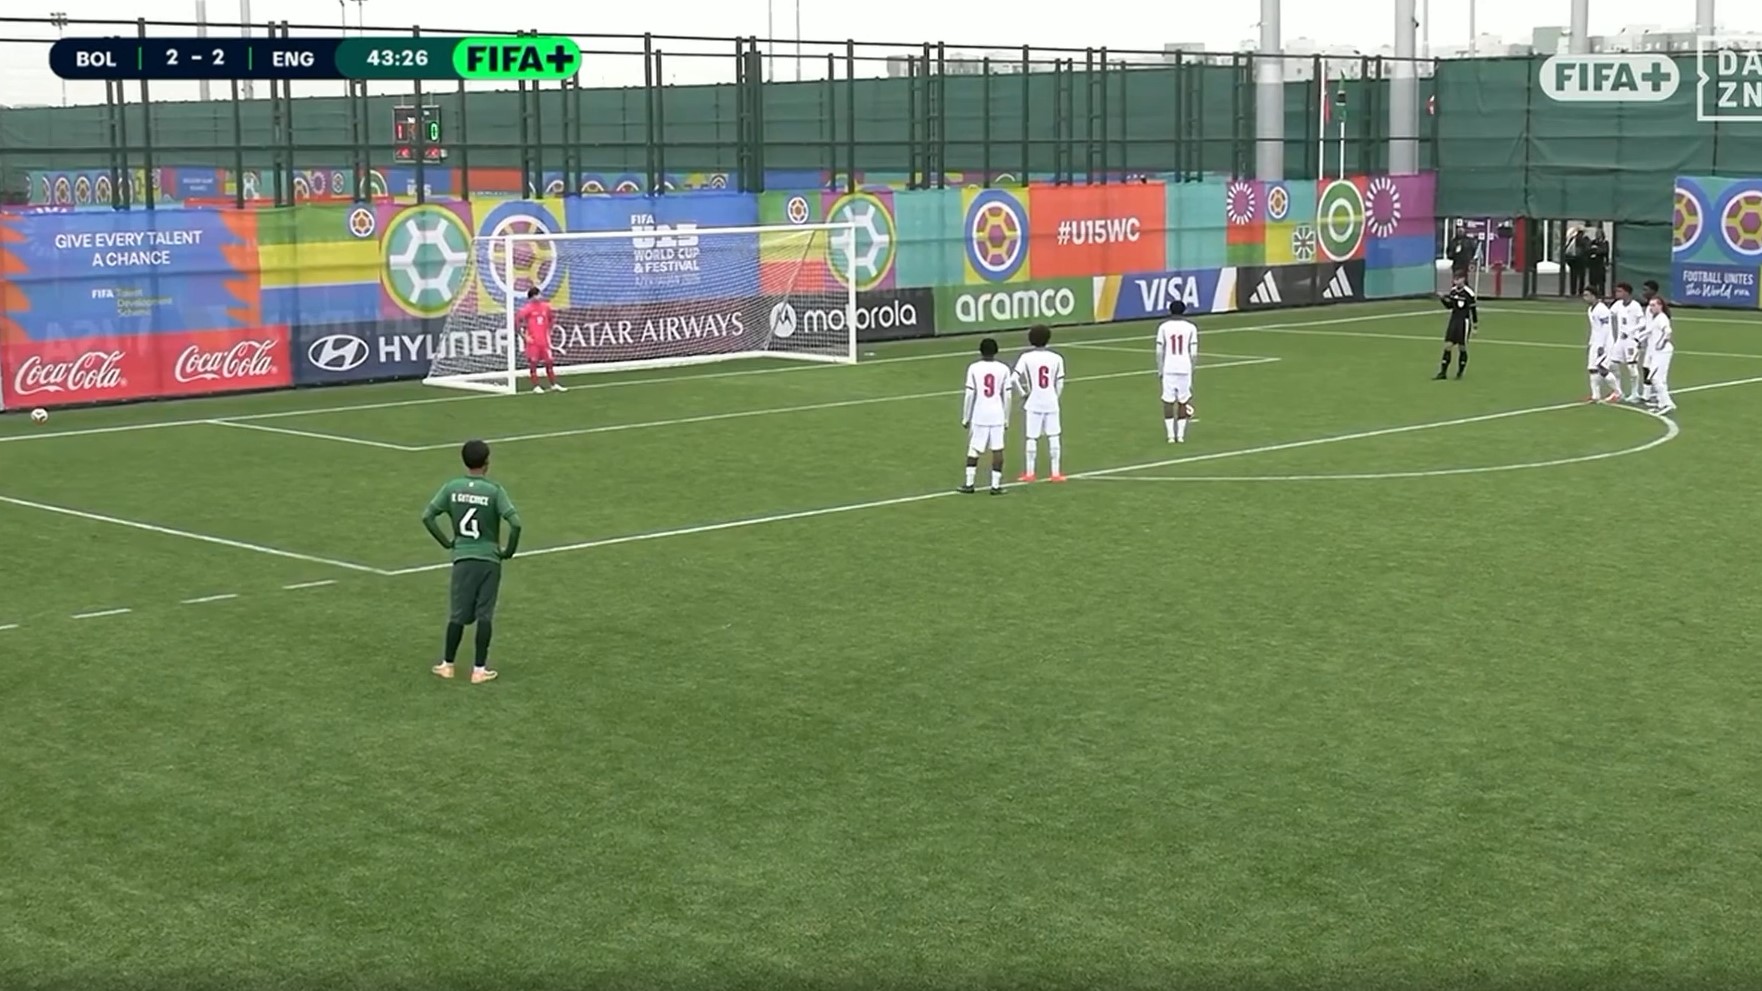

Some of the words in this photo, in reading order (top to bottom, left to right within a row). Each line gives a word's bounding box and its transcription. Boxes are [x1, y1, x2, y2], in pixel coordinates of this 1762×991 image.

[430, 122, 439, 141] 0
[630, 214, 655, 225] FIFA
[55, 233, 92, 249] GIVE
[95, 231, 144, 248] EVERY
[147, 230, 203, 246] TALENT
[1057, 217, 1141, 246] #U15WC
[92, 253, 104, 267] A
[106, 251, 170, 266] CHANCE
[633, 249, 675, 262] WORLD
[677, 247, 701, 260] CUP
[633, 262, 643, 274] &
[645, 260, 700, 273] FESTIVAL
[1683, 270, 1722, 284] FOOTBALL
[1723, 272, 1754, 285] UNITES
[92, 289, 114, 299] FIFA
[1135, 276, 1200, 313] VISA
[1702, 283, 1733, 300] World
[956, 288, 1075, 323] aramco
[547, 319, 634, 355] QATAR
[641, 311, 745, 343] AIRWAYS
[1170, 334, 1184, 355] 11
[983, 373, 995, 398] 9
[1038, 365, 1050, 389] 6
[459, 508, 480, 540] 4
